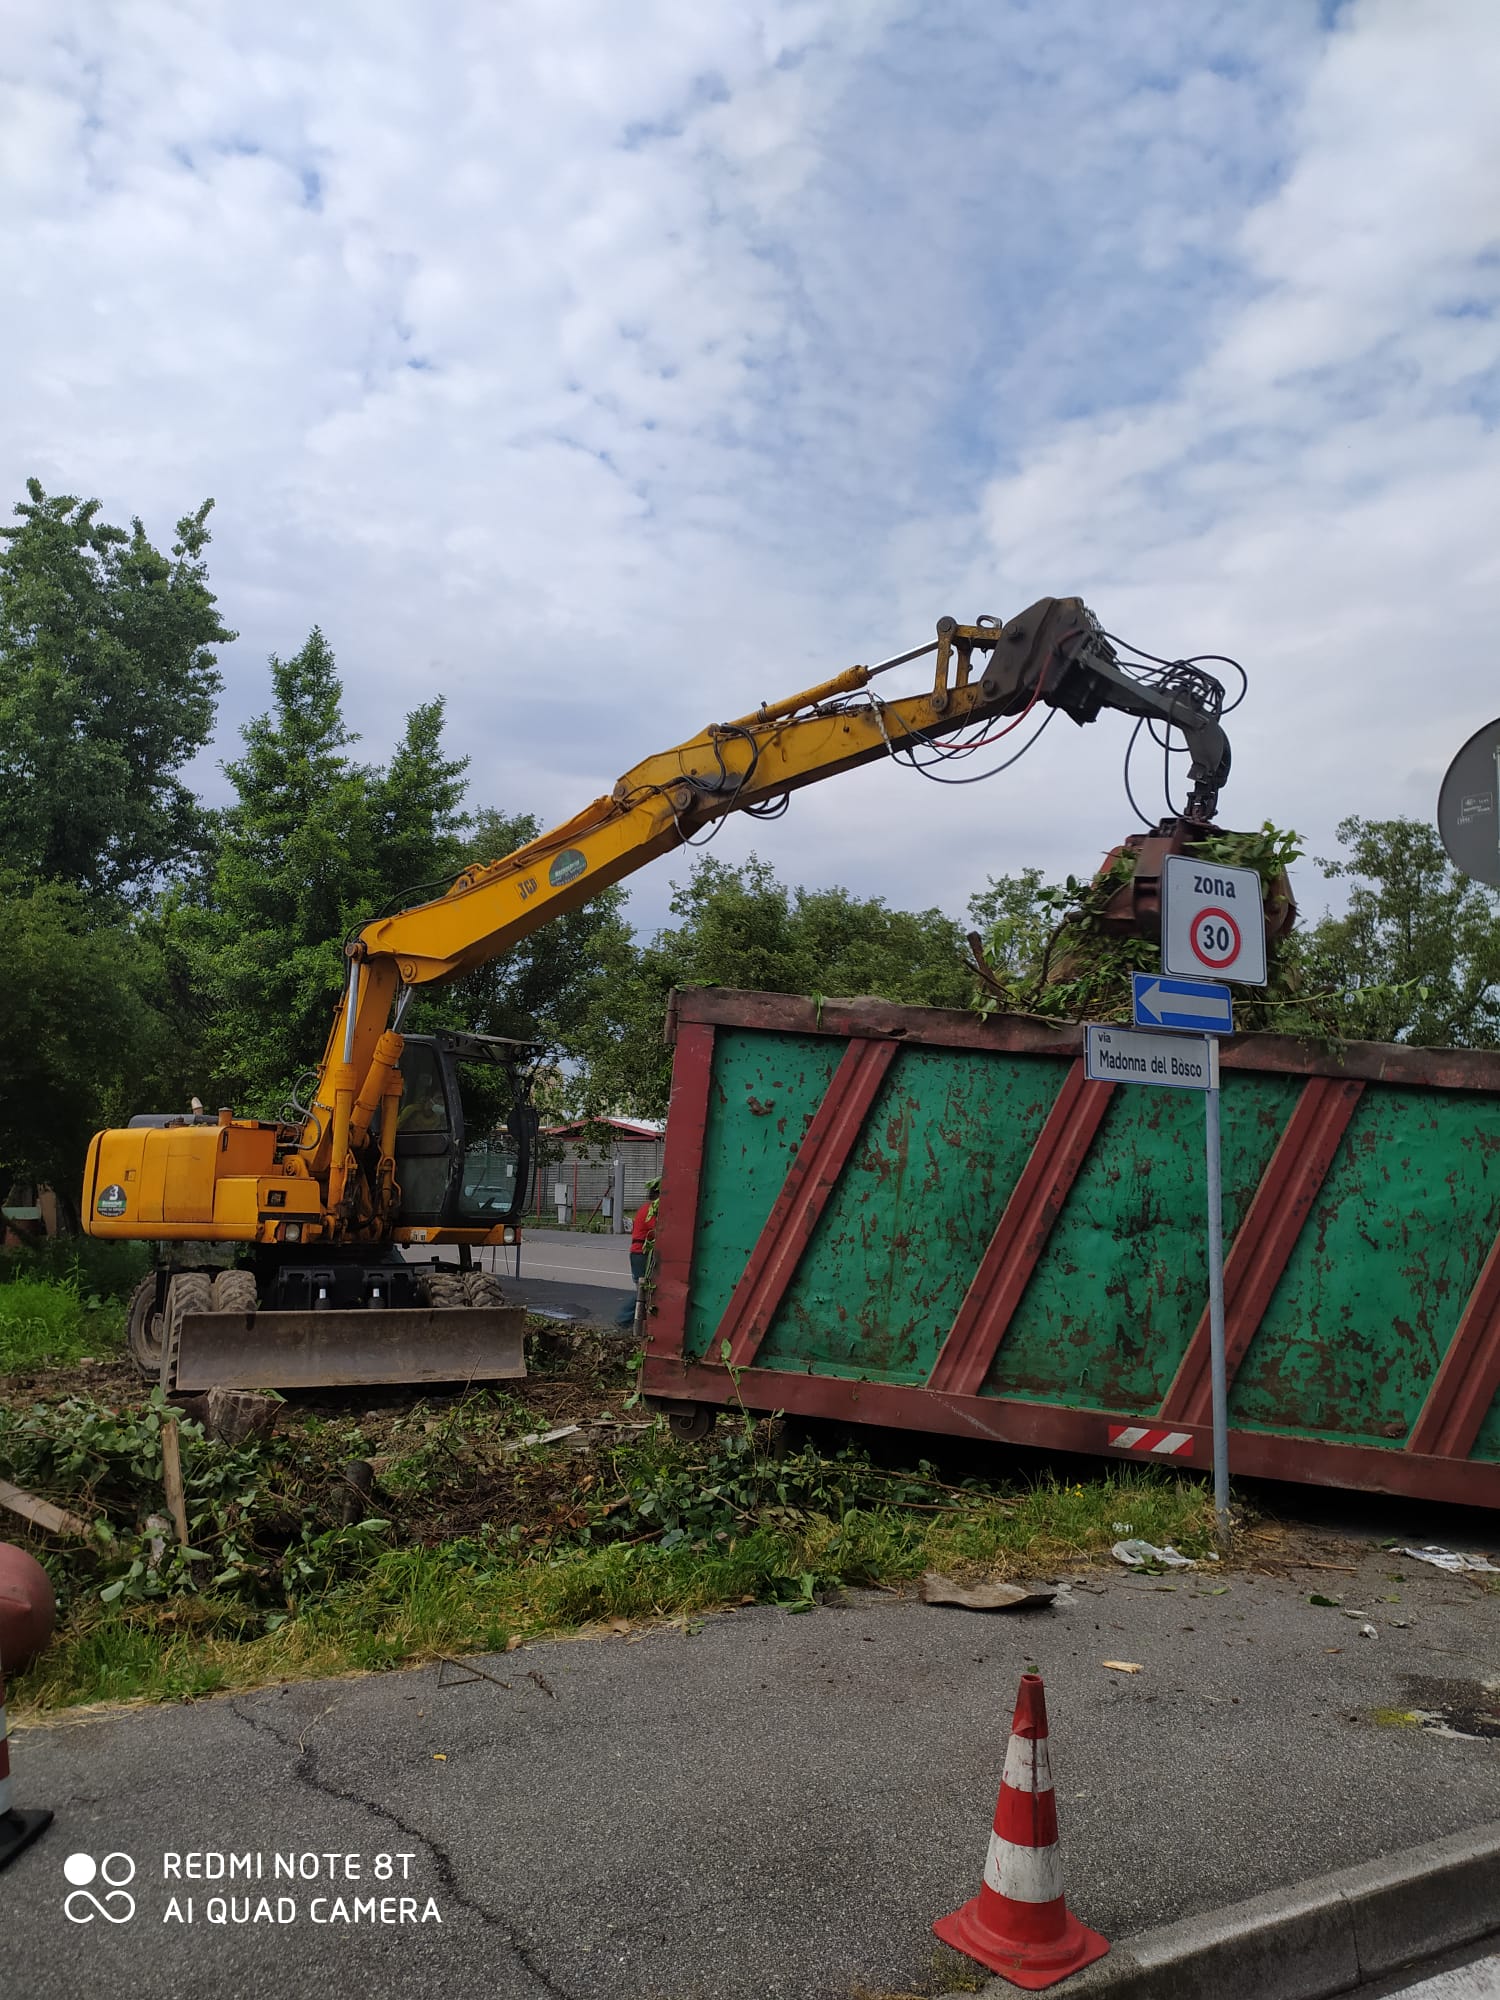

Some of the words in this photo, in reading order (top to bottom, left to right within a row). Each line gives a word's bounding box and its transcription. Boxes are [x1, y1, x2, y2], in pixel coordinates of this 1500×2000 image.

[1194, 875, 1236, 899] zona
[1203, 925, 1230, 951] 30
[1098, 1032, 1112, 1043] via
[1100, 1049, 1147, 1072] Madonna
[1151, 1056, 1168, 1074] del
